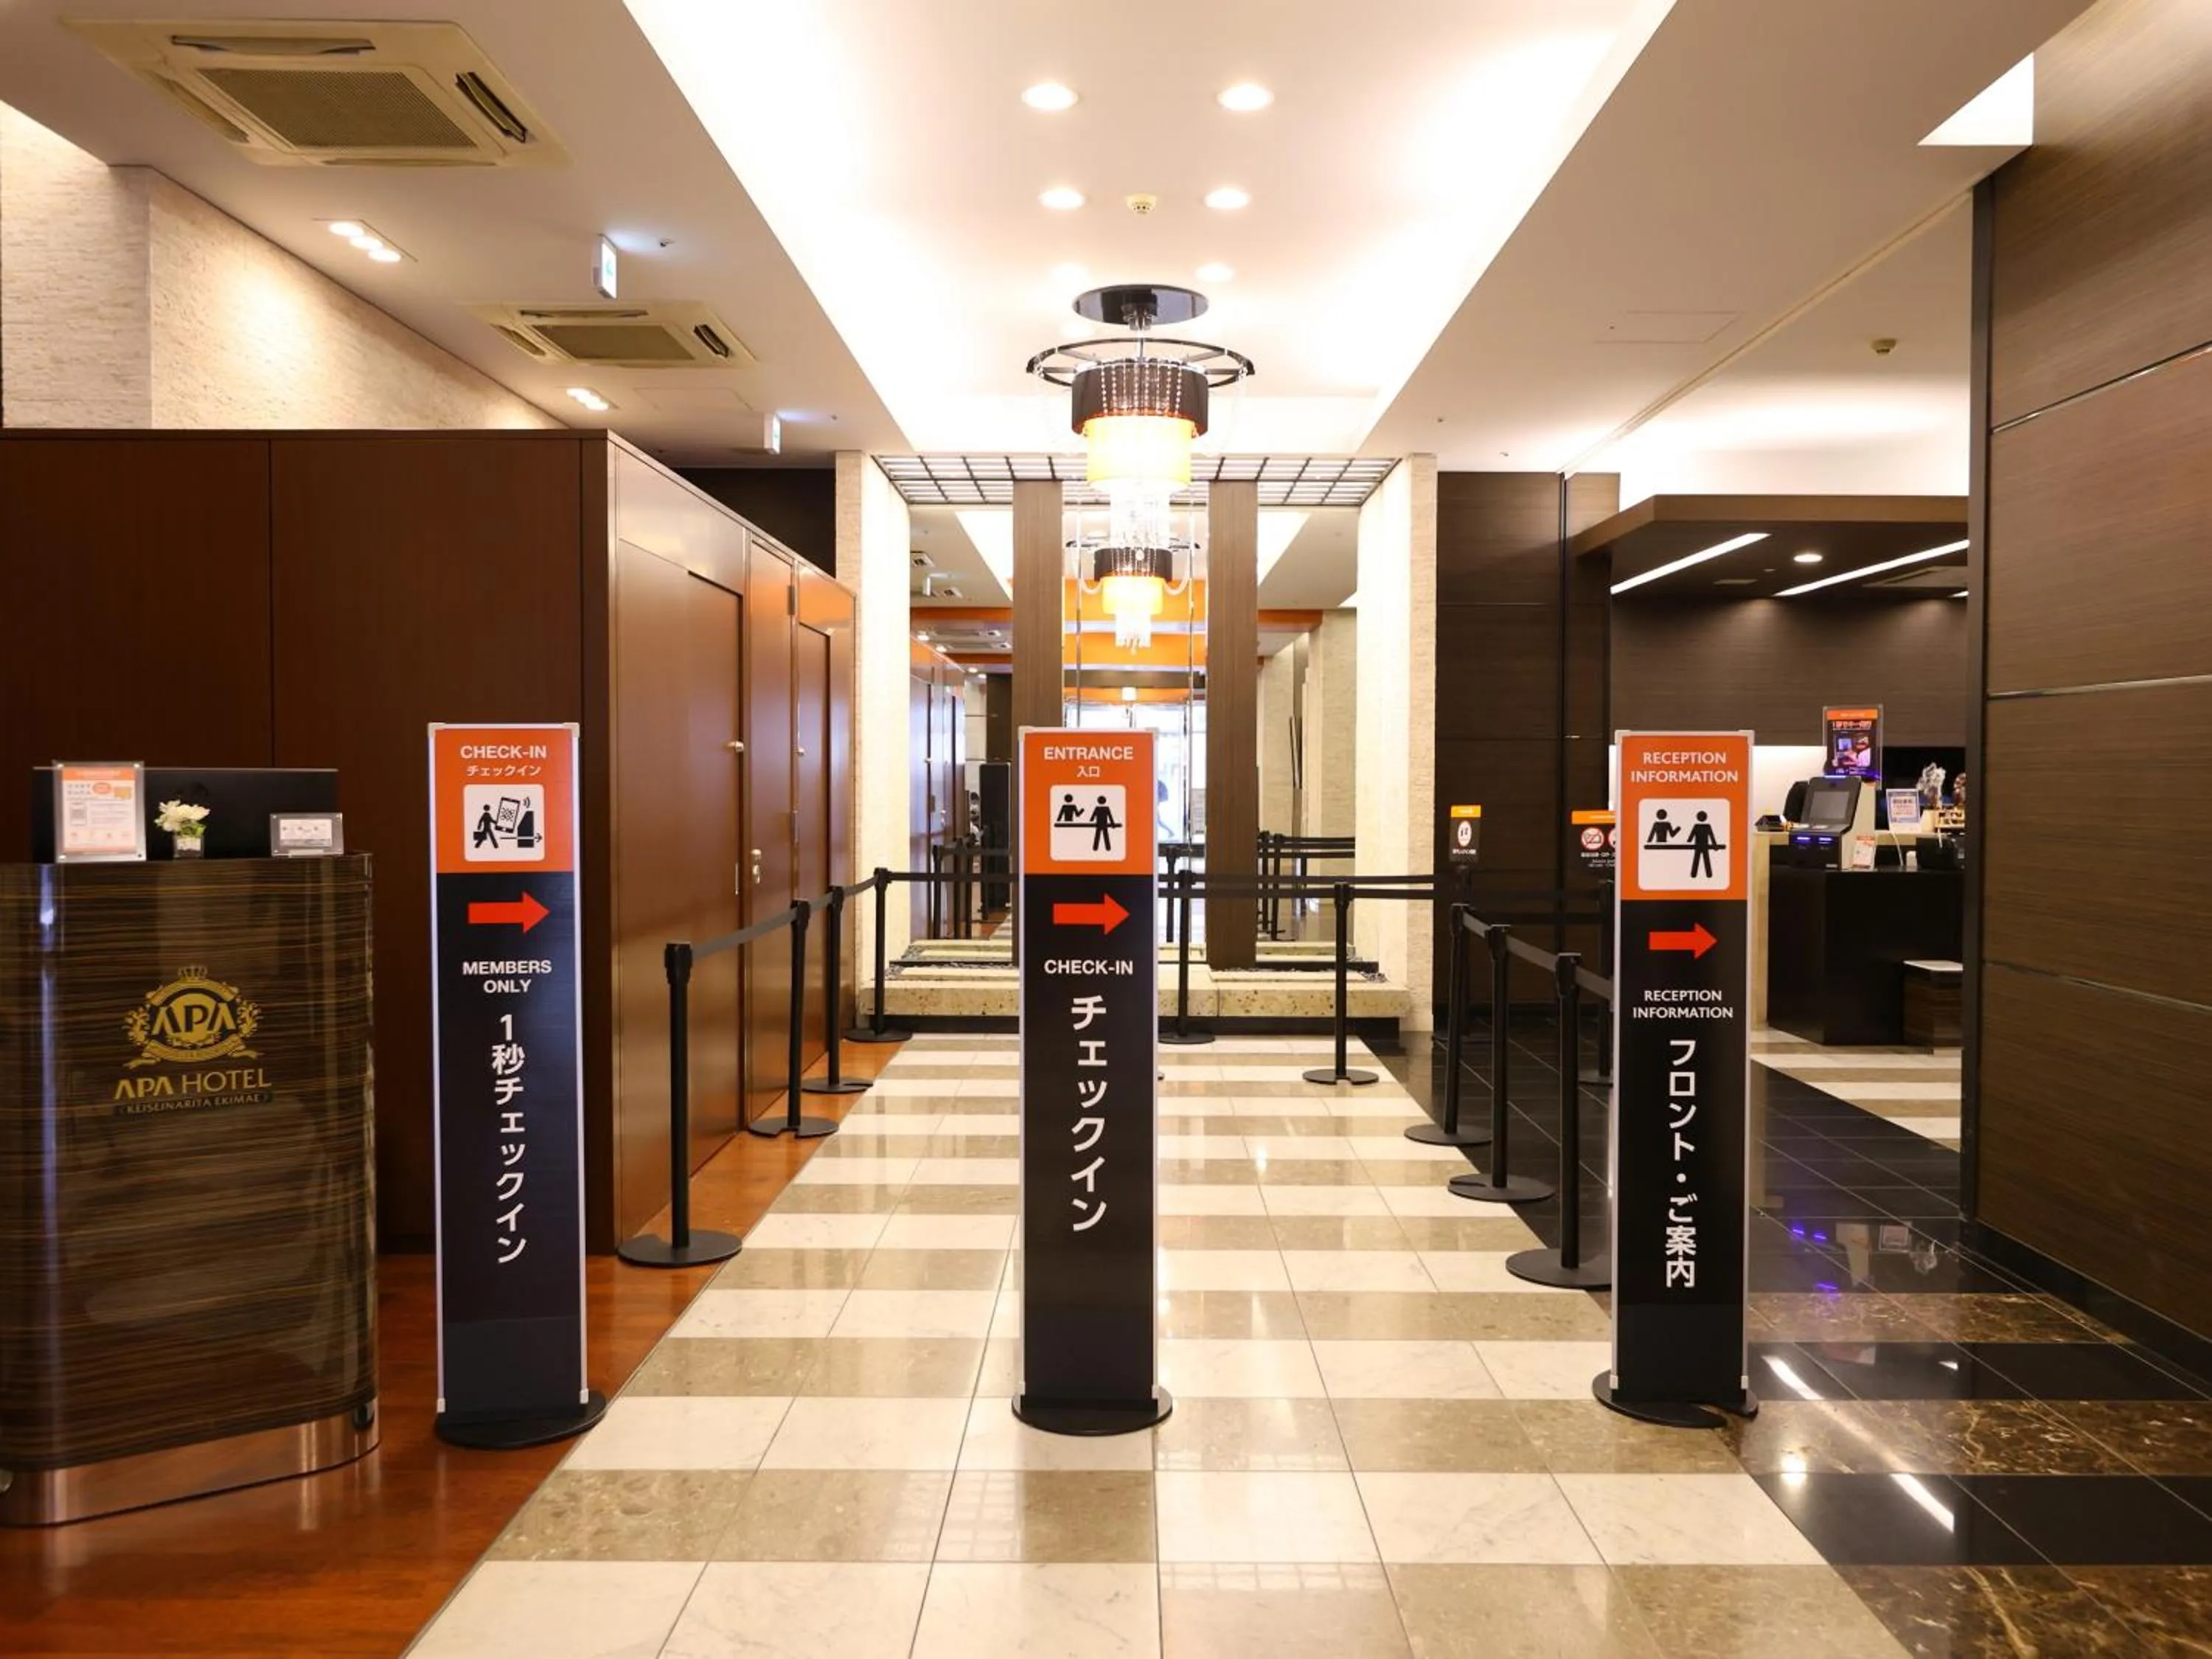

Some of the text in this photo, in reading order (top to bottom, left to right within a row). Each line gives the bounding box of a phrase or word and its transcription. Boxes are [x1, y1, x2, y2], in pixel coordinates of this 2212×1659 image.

[460, 745, 546, 759] CHECK-IN
[1043, 746, 1134, 760] ENTRANCE
[1643, 751, 1727, 765] RECEPTION
[466, 765, 542, 776] チェックイン
[1077, 766, 1101, 778] 入口
[1630, 770, 1739, 782] INFORMATION
[462, 960, 552, 975] MEMBERS
[1044, 960, 1133, 975] CHECK-IN
[483, 979, 532, 994] ONLY
[1644, 990, 1722, 1001] RECEPTION
[151, 1002, 237, 1035] APA
[1632, 1006, 1733, 1018] INFORMATION
[114, 1068, 272, 1100] APA HOTEL
[215, 1093, 260, 1106] EKIMAE
[1071, 995, 1108, 1232] チェックイン
[492, 1014, 527, 1263] 1秒チェックイン
[1665, 1040, 1699, 1288] フロント・ご案内
